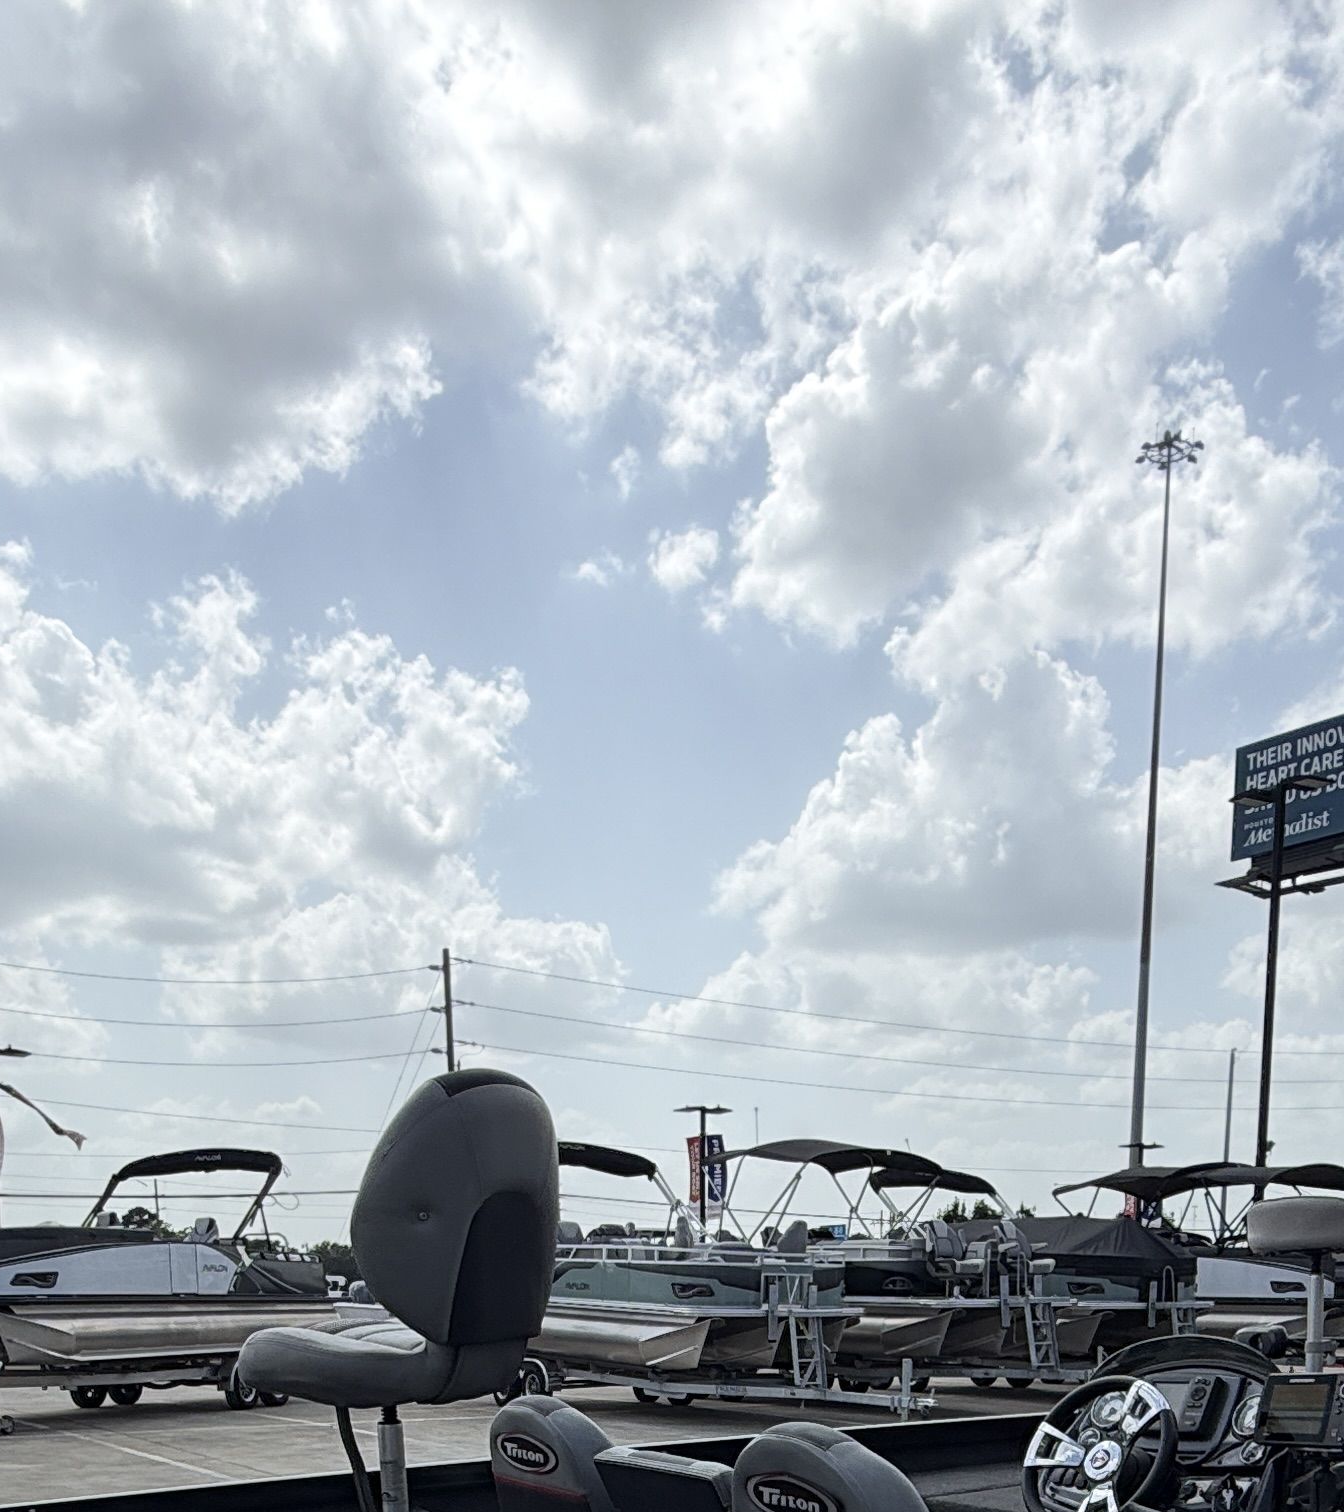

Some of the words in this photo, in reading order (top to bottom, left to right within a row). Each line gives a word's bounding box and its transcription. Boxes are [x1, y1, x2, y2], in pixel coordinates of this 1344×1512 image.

[1246, 762, 1297, 791] HEART
[1300, 748, 1344, 776] CARE
[1247, 742, 1292, 771] THEIR
[712, 1139, 722, 1194] PRMIER
[503, 1441, 544, 1464] Triton
